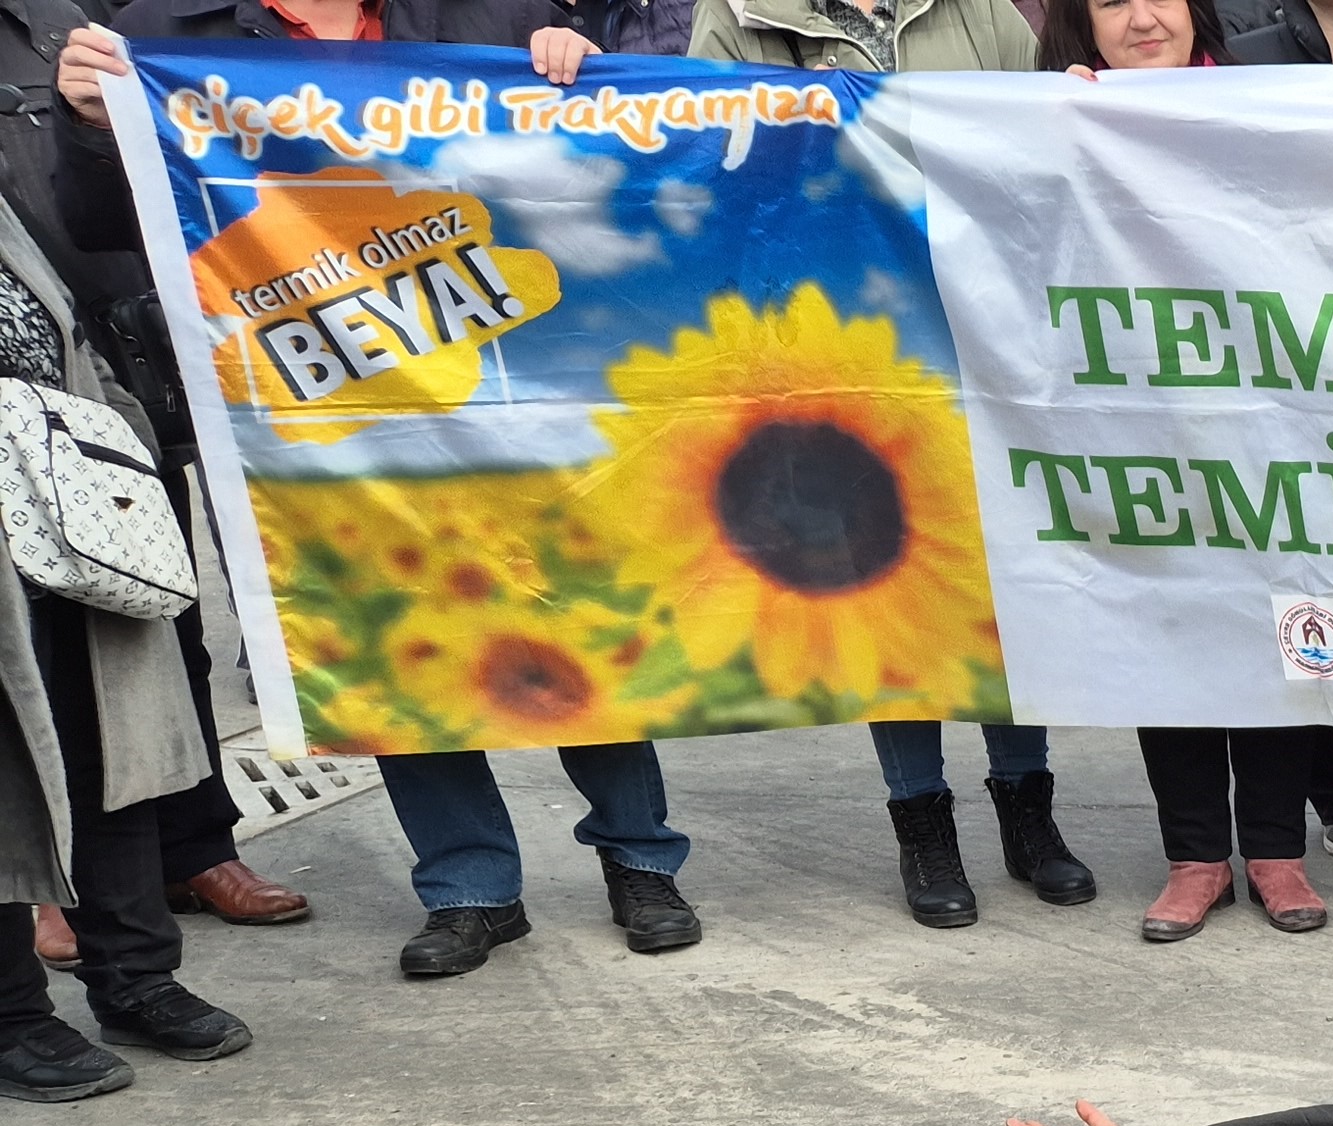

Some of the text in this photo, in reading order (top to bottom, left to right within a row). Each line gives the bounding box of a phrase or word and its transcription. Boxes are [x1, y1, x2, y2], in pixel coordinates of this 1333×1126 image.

[364, 77, 488, 152] gibi
[500, 82, 840, 170] Trakyamıza
[232, 206, 472, 318] termik olmaz
[257, 243, 525, 401] BEYA!
